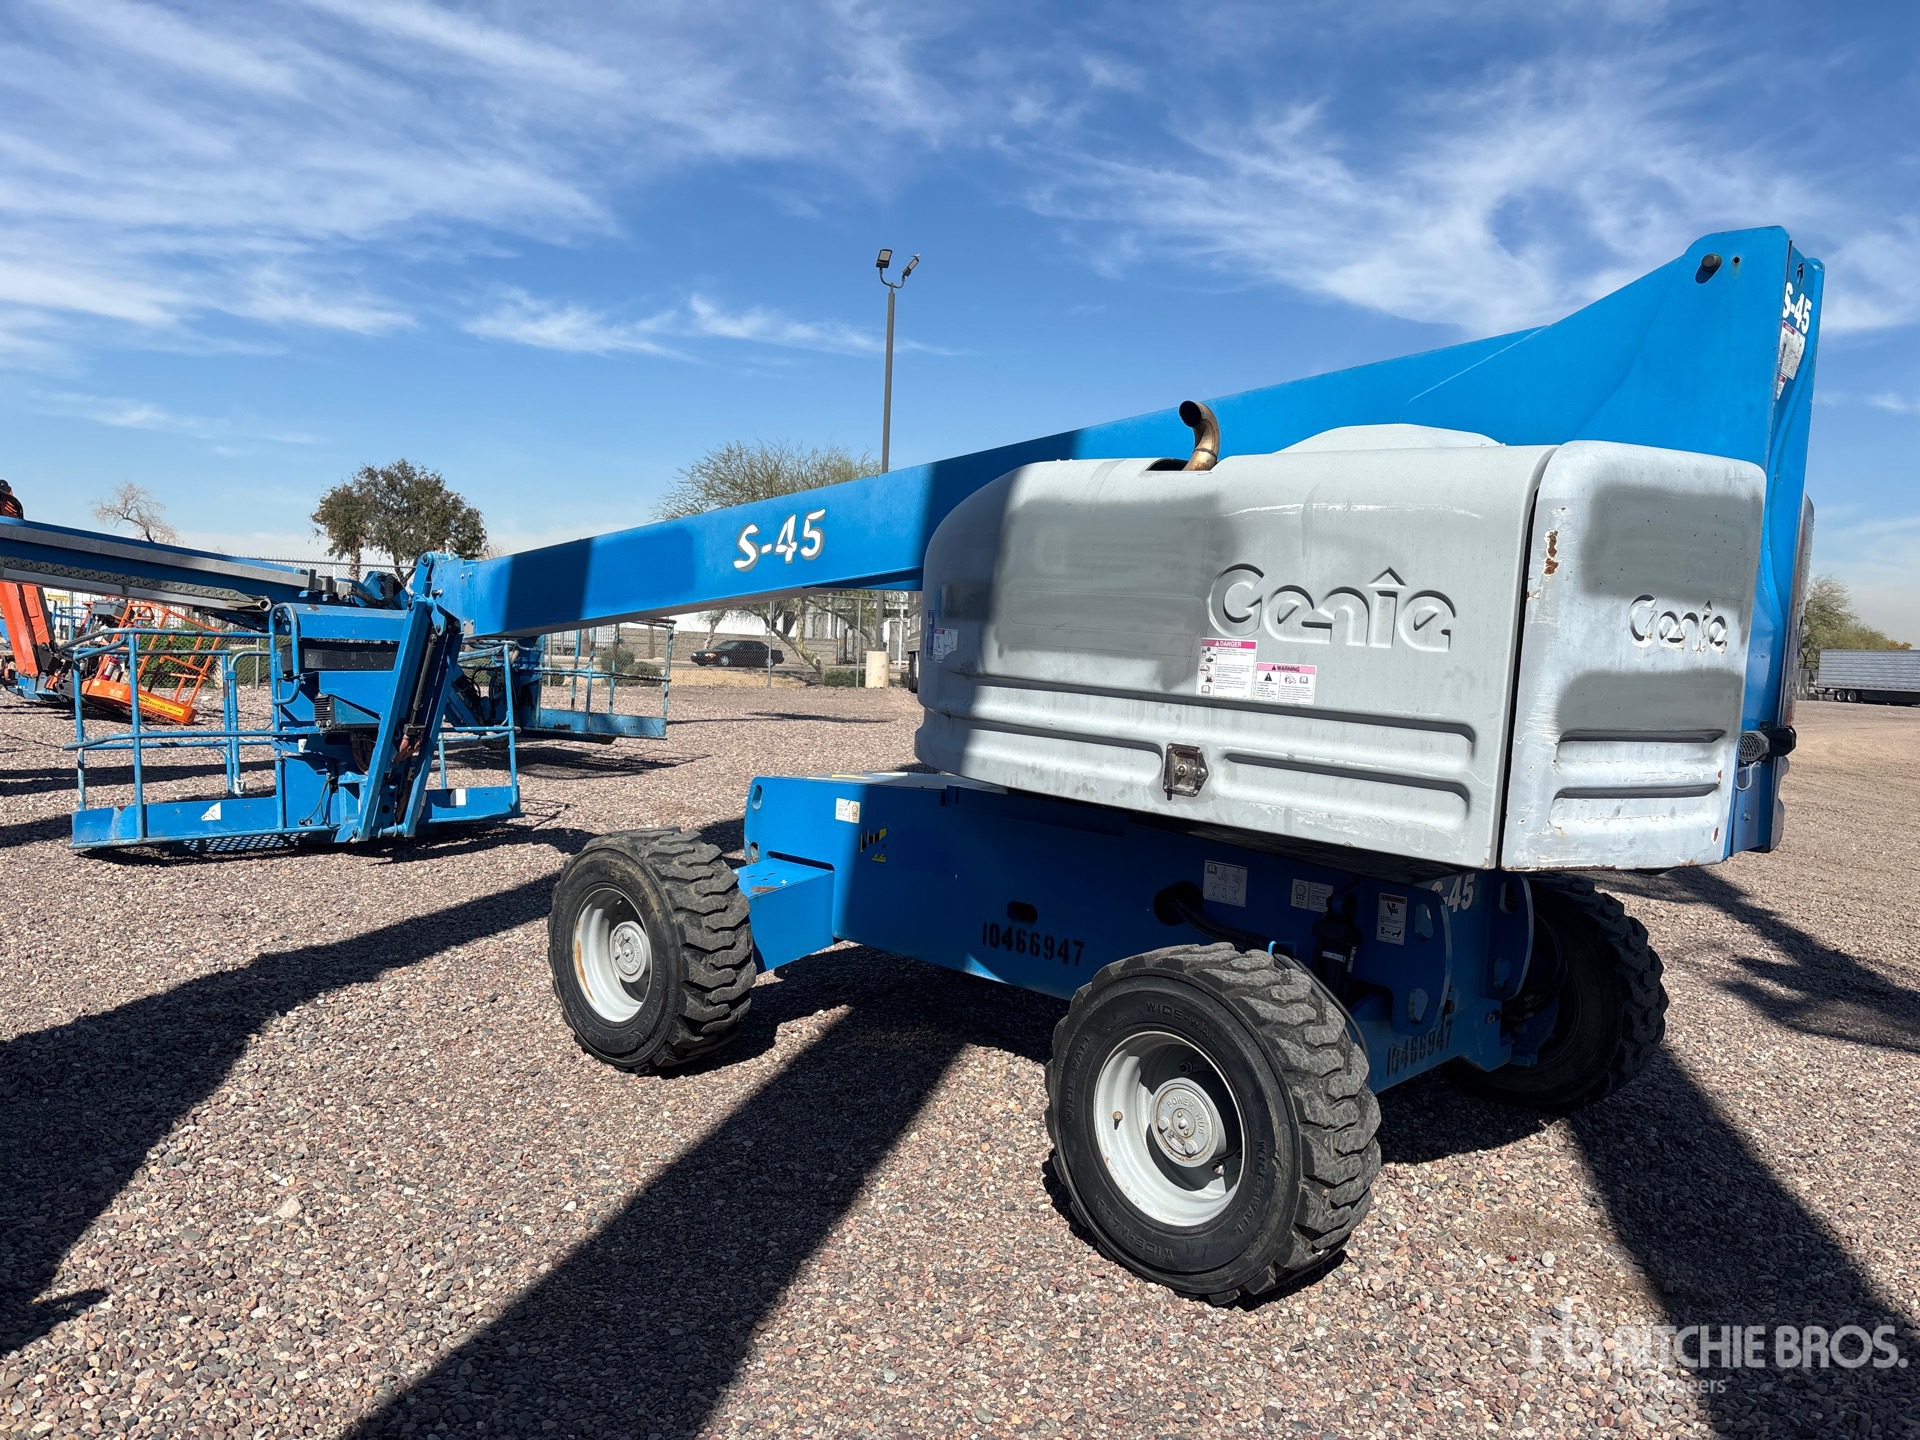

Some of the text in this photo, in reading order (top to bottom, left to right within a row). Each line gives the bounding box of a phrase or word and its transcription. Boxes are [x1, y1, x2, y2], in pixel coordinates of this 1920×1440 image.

[1782, 282, 1812, 334] S-45
[733, 508, 826, 572] S-45
[1219, 640, 1242, 648] DANGER
[1276, 665, 1300, 673] WARNING
[982, 921, 1085, 967] 10466947
